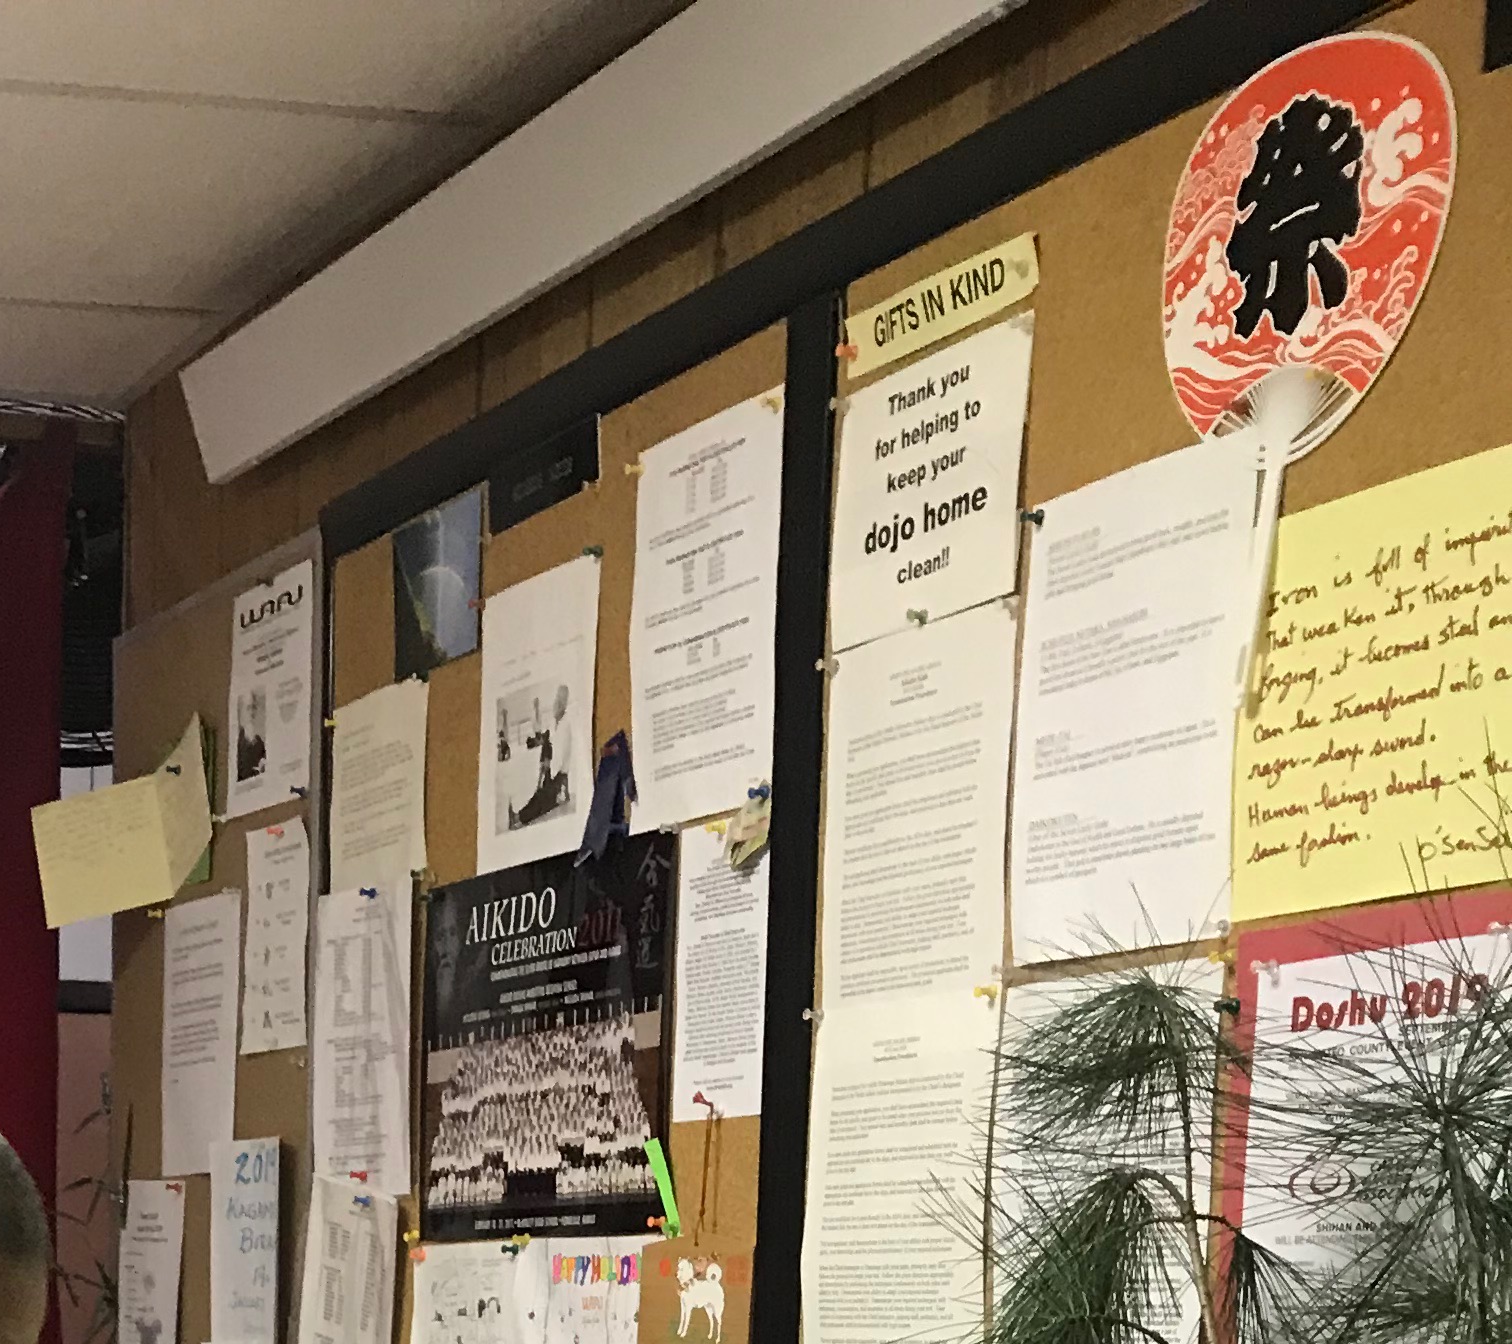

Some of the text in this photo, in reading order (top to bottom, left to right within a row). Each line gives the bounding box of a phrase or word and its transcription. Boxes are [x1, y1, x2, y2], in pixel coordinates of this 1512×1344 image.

[874, 257, 1006, 347] GIFTS IN KIND
[888, 364, 971, 416] Thank you
[875, 398, 982, 461] for helping to
[887, 445, 967, 494] keep your
[864, 485, 989, 554] dojo home
[896, 546, 951, 585] clean!!
[1333, 554, 1353, 589] is
[1367, 546, 1401, 586] full
[1413, 533, 1431, 570] of
[1330, 640, 1350, 678] it
[1358, 636, 1430, 669] becomes
[1438, 603, 1480, 647] steel
[1450, 657, 1484, 694] into
[1314, 781, 1378, 814] beings
[1458, 756, 1477, 782] in
[465, 886, 557, 945] AIKIDO
[491, 926, 578, 966] CELEBRATION
[1290, 988, 1388, 1033] Doshu
